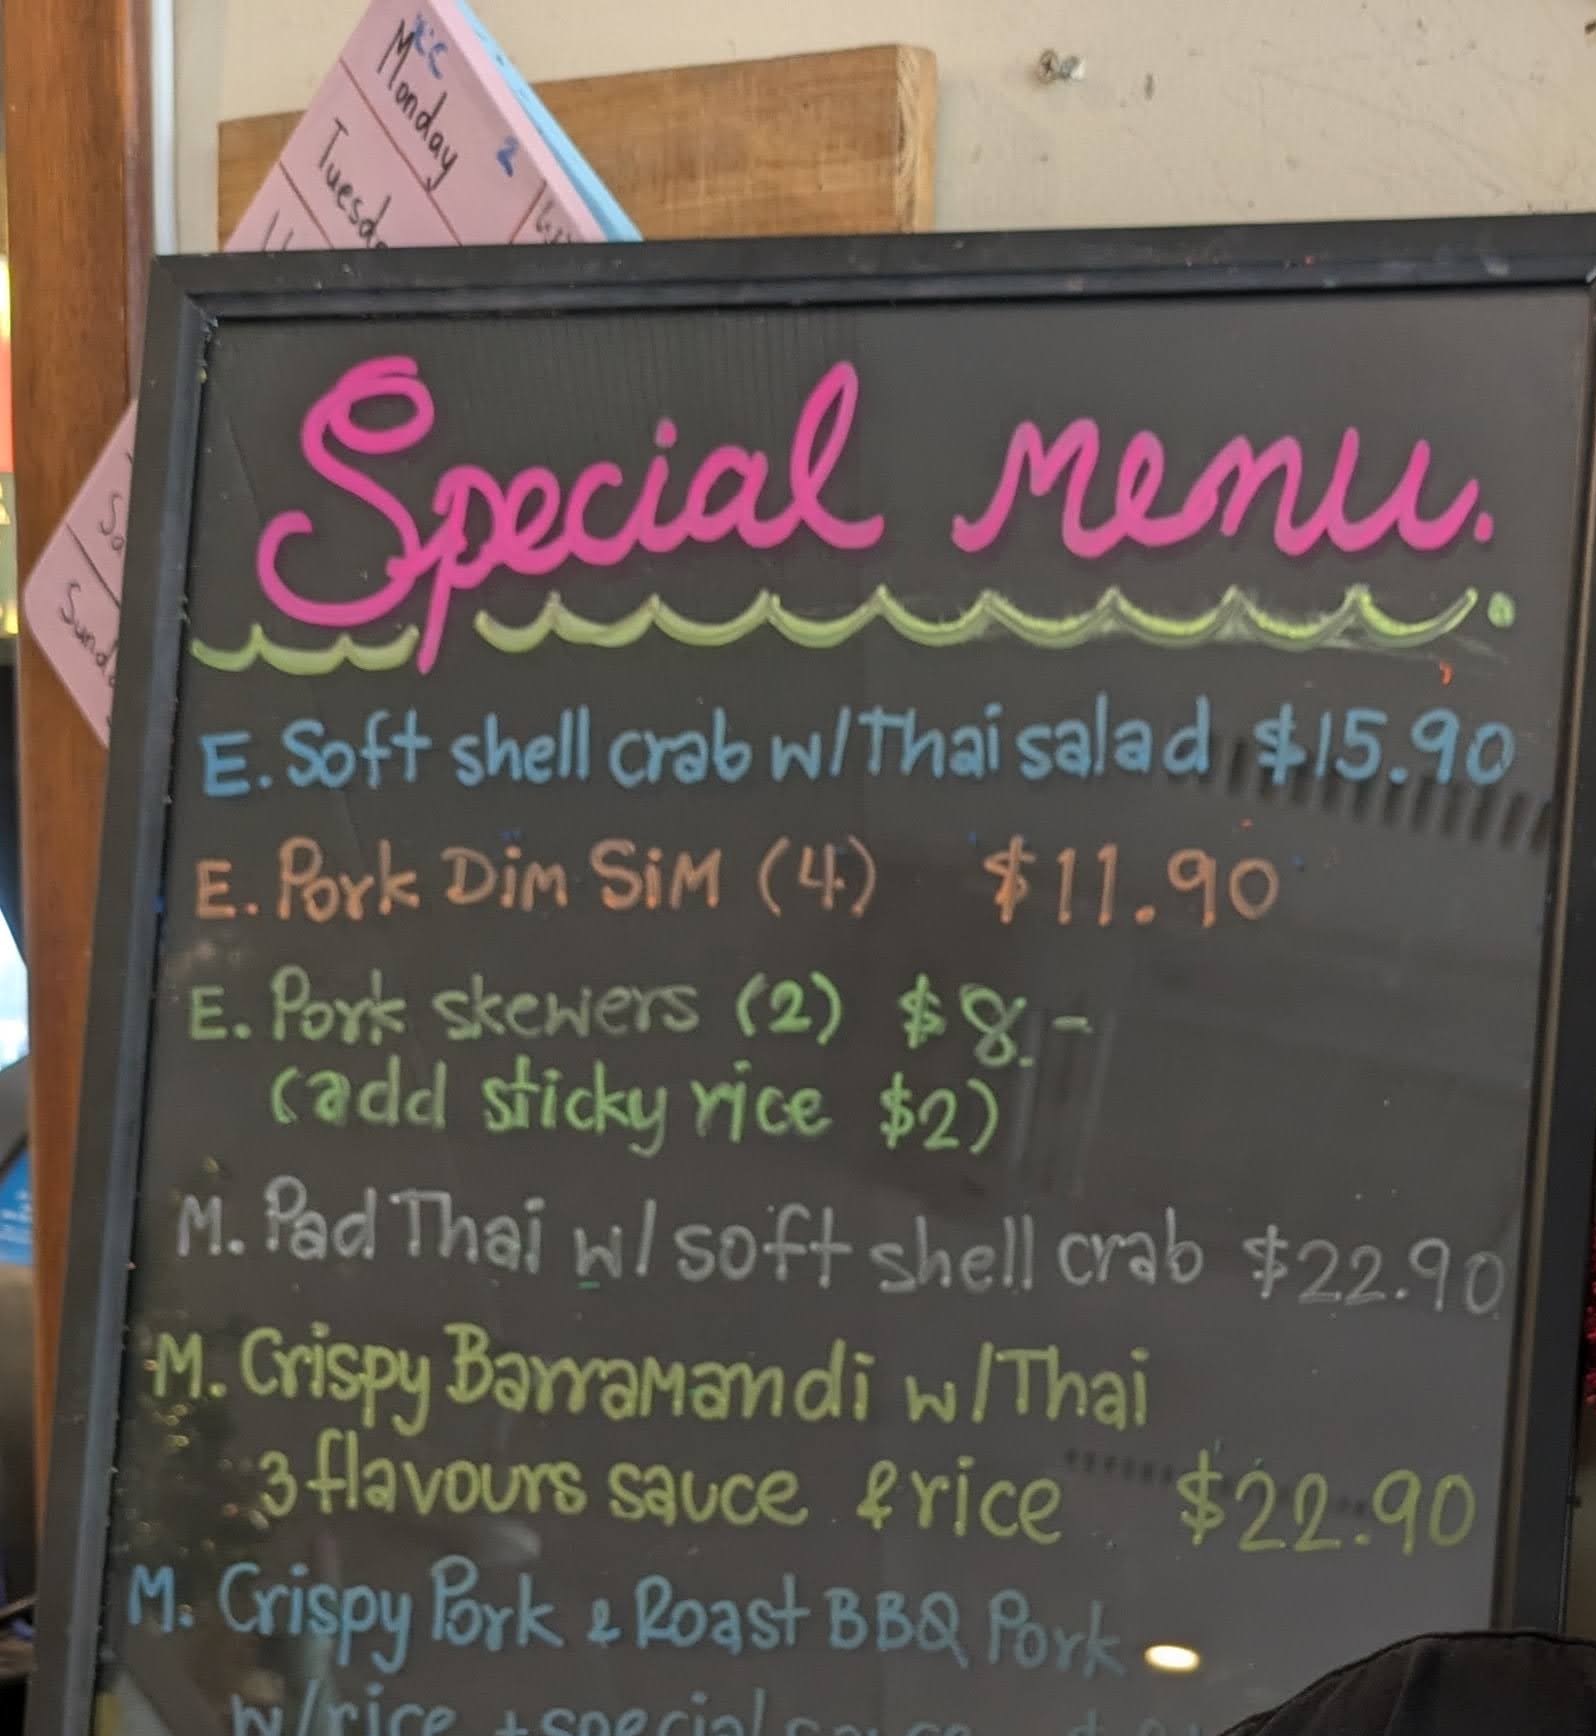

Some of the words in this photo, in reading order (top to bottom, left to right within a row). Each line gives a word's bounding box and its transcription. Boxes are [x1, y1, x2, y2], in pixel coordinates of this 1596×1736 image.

[374, 17, 459, 193] Monday
[317, 116, 391, 250] Tuesd
[257, 355, 884, 674] Special
[200, 730, 271, 797] E.
[282, 710, 431, 788] Soft
[451, 705, 590, 786] shell
[610, 708, 753, 787] crab
[1016, 692, 1211, 781] salad
[1254, 703, 1515, 785] $15.90
[195, 859, 259, 920] E.
[278, 836, 422, 922] Pork
[758, 834, 876, 918] (4)
[984, 836, 1279, 928] $11.90
[190, 987, 252, 1041] E.
[271, 965, 406, 1045] Pork
[432, 972, 699, 1041] skewers
[736, 970, 843, 1045] (2)
[270, 1054, 447, 1125] (add
[482, 1054, 668, 1157] sticky
[691, 1060, 832, 1142] rice
[880, 1071, 999, 1154] $2)
[177, 1195, 246, 1256] M.
[264, 1174, 377, 1261] Pad
[389, 1187, 546, 1275] Thai
[869, 1215, 1034, 1293] shell
[1057, 1206, 1203, 1285] crab
[1242, 1224, 1505, 1315] $22.90
[153, 1333, 227, 1399] M.
[239, 1322, 431, 1437] Crispy
[608, 1462, 809, 1526] sauce
[1175, 1449, 1477, 1555] $22.90
[127, 1564, 194, 1635] M.
[217, 1560, 413, 1675] Crispy
[430, 1553, 564, 1652] Pork
[635, 1574, 811, 1656] Roast
[822, 1586, 969, 1670] BBQ
[987, 1588, 1128, 1678] Pork
